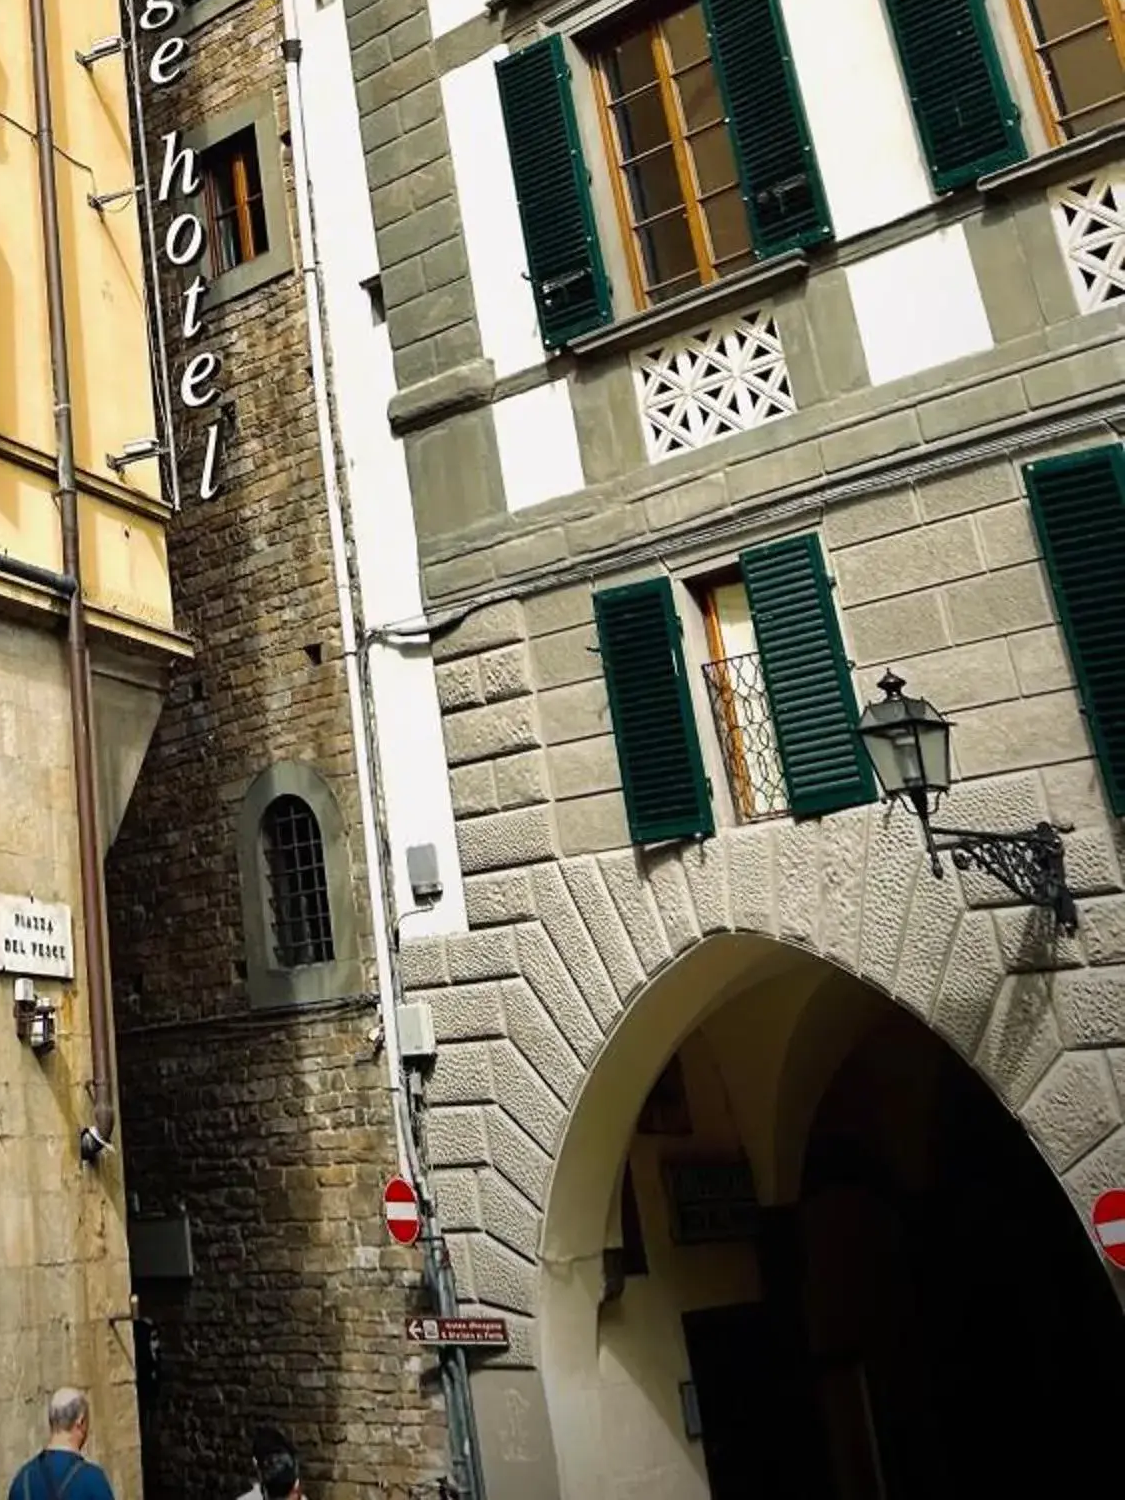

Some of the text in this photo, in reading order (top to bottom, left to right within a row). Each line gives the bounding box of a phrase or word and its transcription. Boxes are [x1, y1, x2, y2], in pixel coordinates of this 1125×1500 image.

[158, 131, 221, 500] hotel
[15, 913, 53, 935] PIAZZA
[4, 938, 66, 960] DEL PESCE
